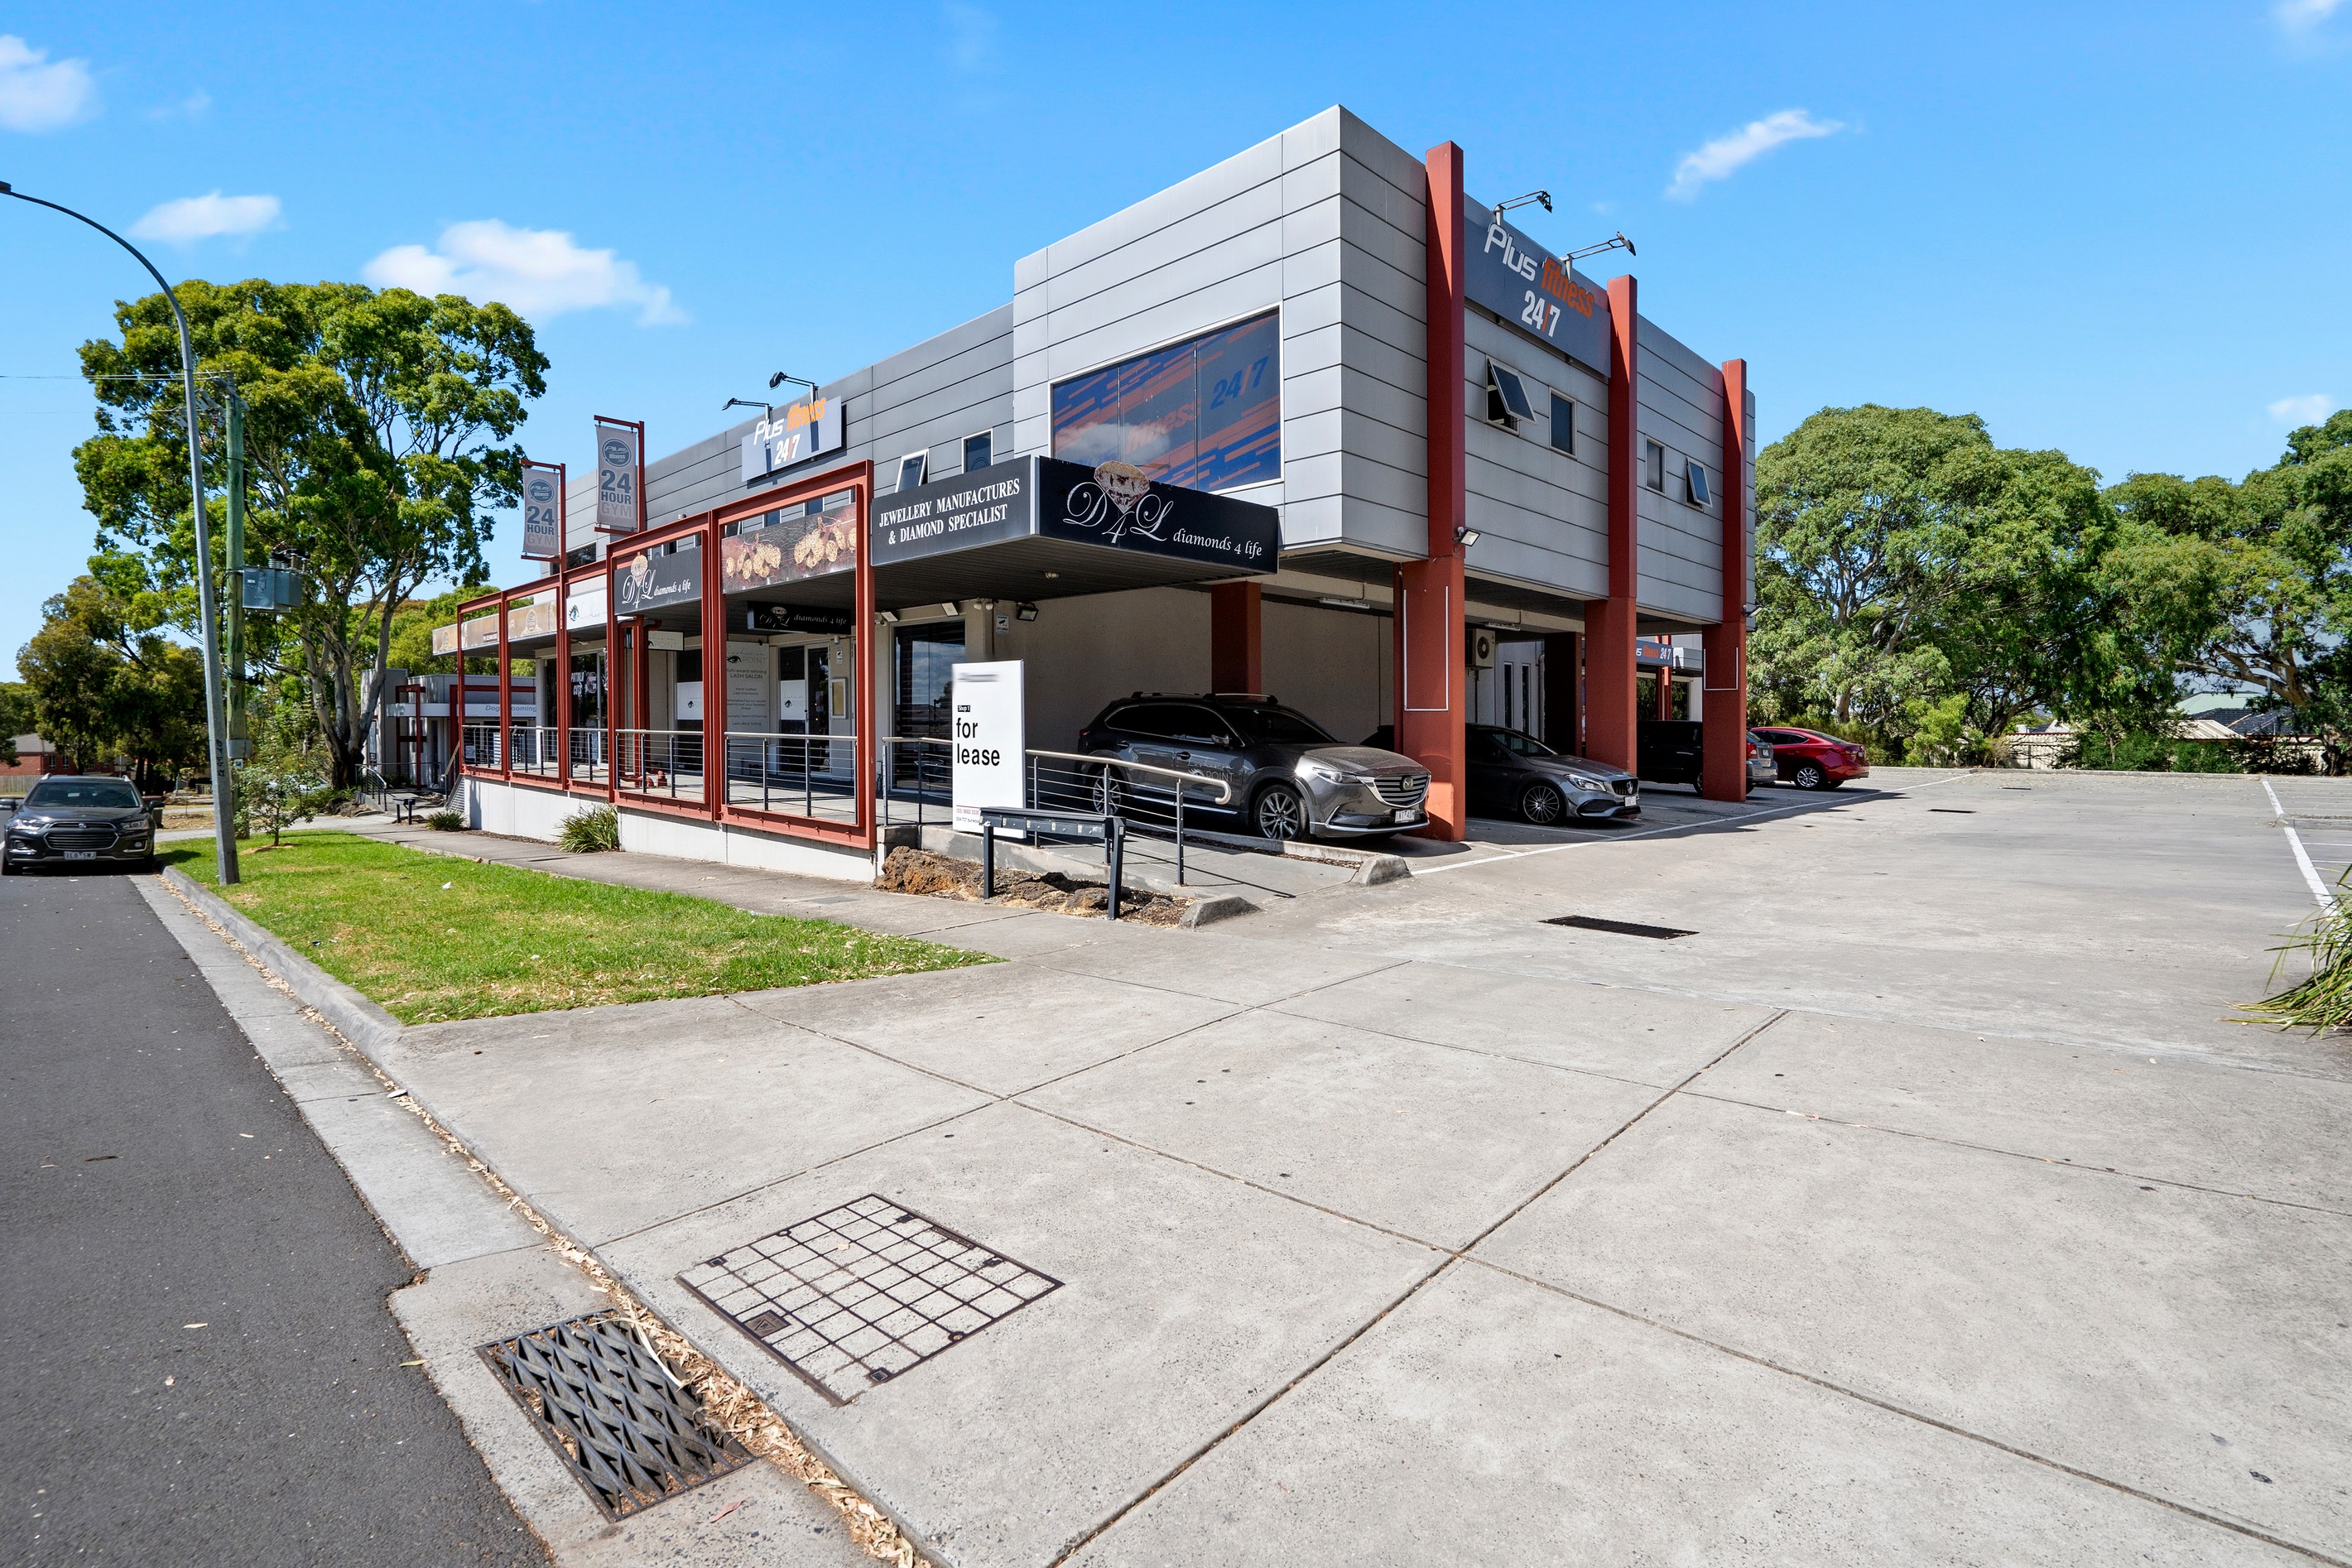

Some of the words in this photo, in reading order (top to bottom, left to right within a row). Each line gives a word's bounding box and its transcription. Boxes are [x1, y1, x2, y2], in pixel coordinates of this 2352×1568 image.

[1484, 223, 1538, 281] Plus
[1541, 257, 1595, 318] fitness
[1521, 290, 1561, 338] 24/7
[1210, 355, 1269, 410] 24/7
[753, 418, 785, 446] Plus
[786, 397, 827, 432] fitness
[774, 433, 801, 465] 24/7
[601, 469, 632, 493] 24
[601, 491, 632, 505] HOUR
[879, 501, 932, 528] JEWELLERY
[936, 478, 1020, 514] MANUFACTURES
[527, 505, 555, 527] 24
[601, 502, 632, 518] GYM
[527, 524, 555, 536] HOUR
[888, 530, 897, 546] &
[900, 519, 945, 543] DIAMOND
[948, 503, 1008, 532] SPECIALIST
[527, 534, 555, 546] GYM
[1173, 528, 1232, 551] diamonds
[1234, 543, 1242, 555] 4
[1244, 540, 1263, 560] life
[653, 581, 677, 597] diamonds
[677, 584, 681, 593] 4
[682, 578, 691, 594] life
[793, 613, 828, 623] diamonds
[835, 617, 847, 627] life
[743, 656, 767, 664] POINT
[956, 717, 979, 738] for
[957, 743, 1000, 766] lease
[1205, 771, 1234, 782] POINT
